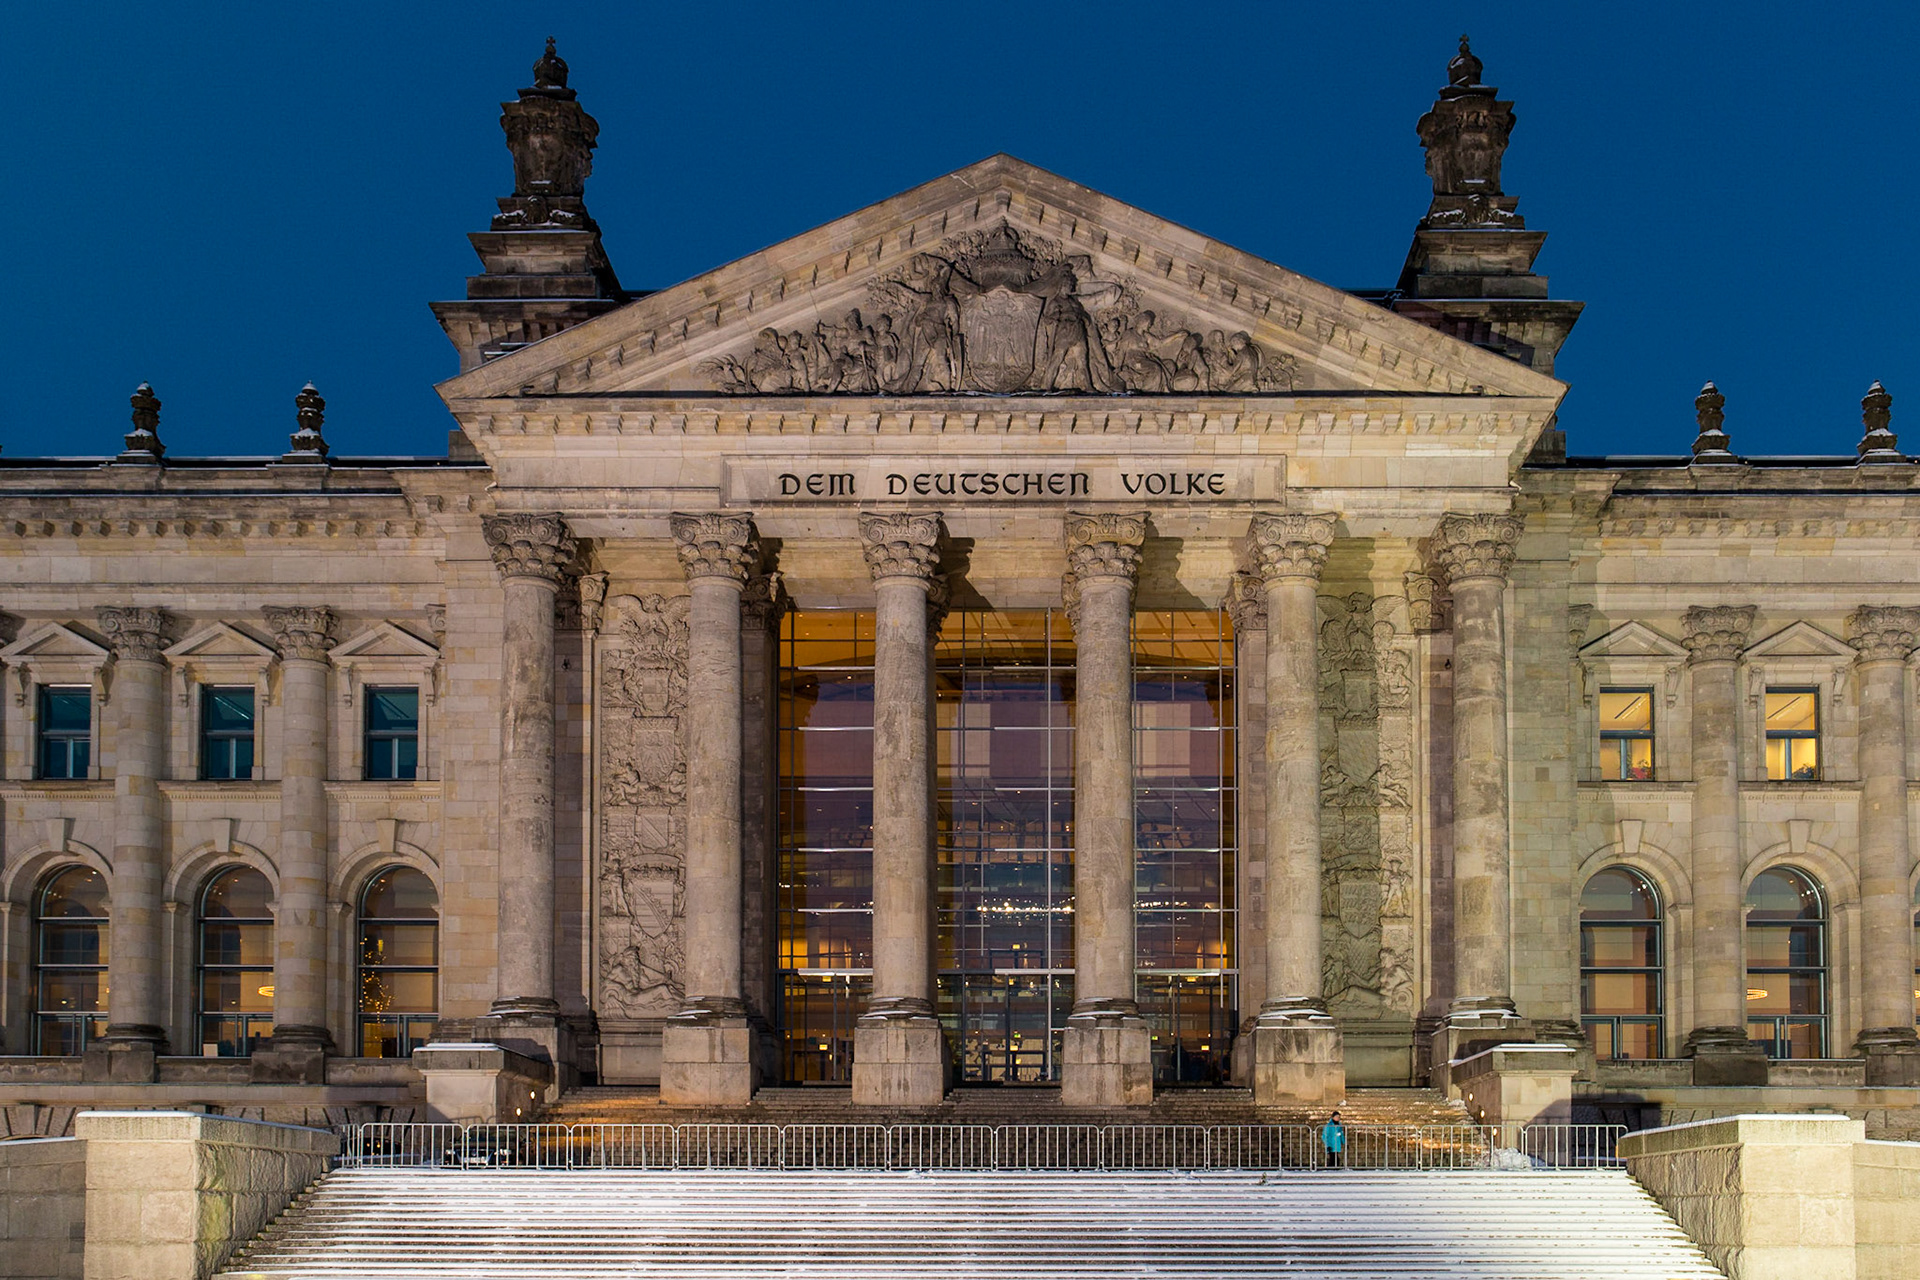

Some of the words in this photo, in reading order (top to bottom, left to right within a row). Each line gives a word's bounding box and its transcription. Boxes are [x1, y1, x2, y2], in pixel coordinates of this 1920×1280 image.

[778, 472, 856, 497] DEM
[885, 472, 1091, 497] DEUTSCHEN
[1120, 472, 1226, 497] VOLKE
